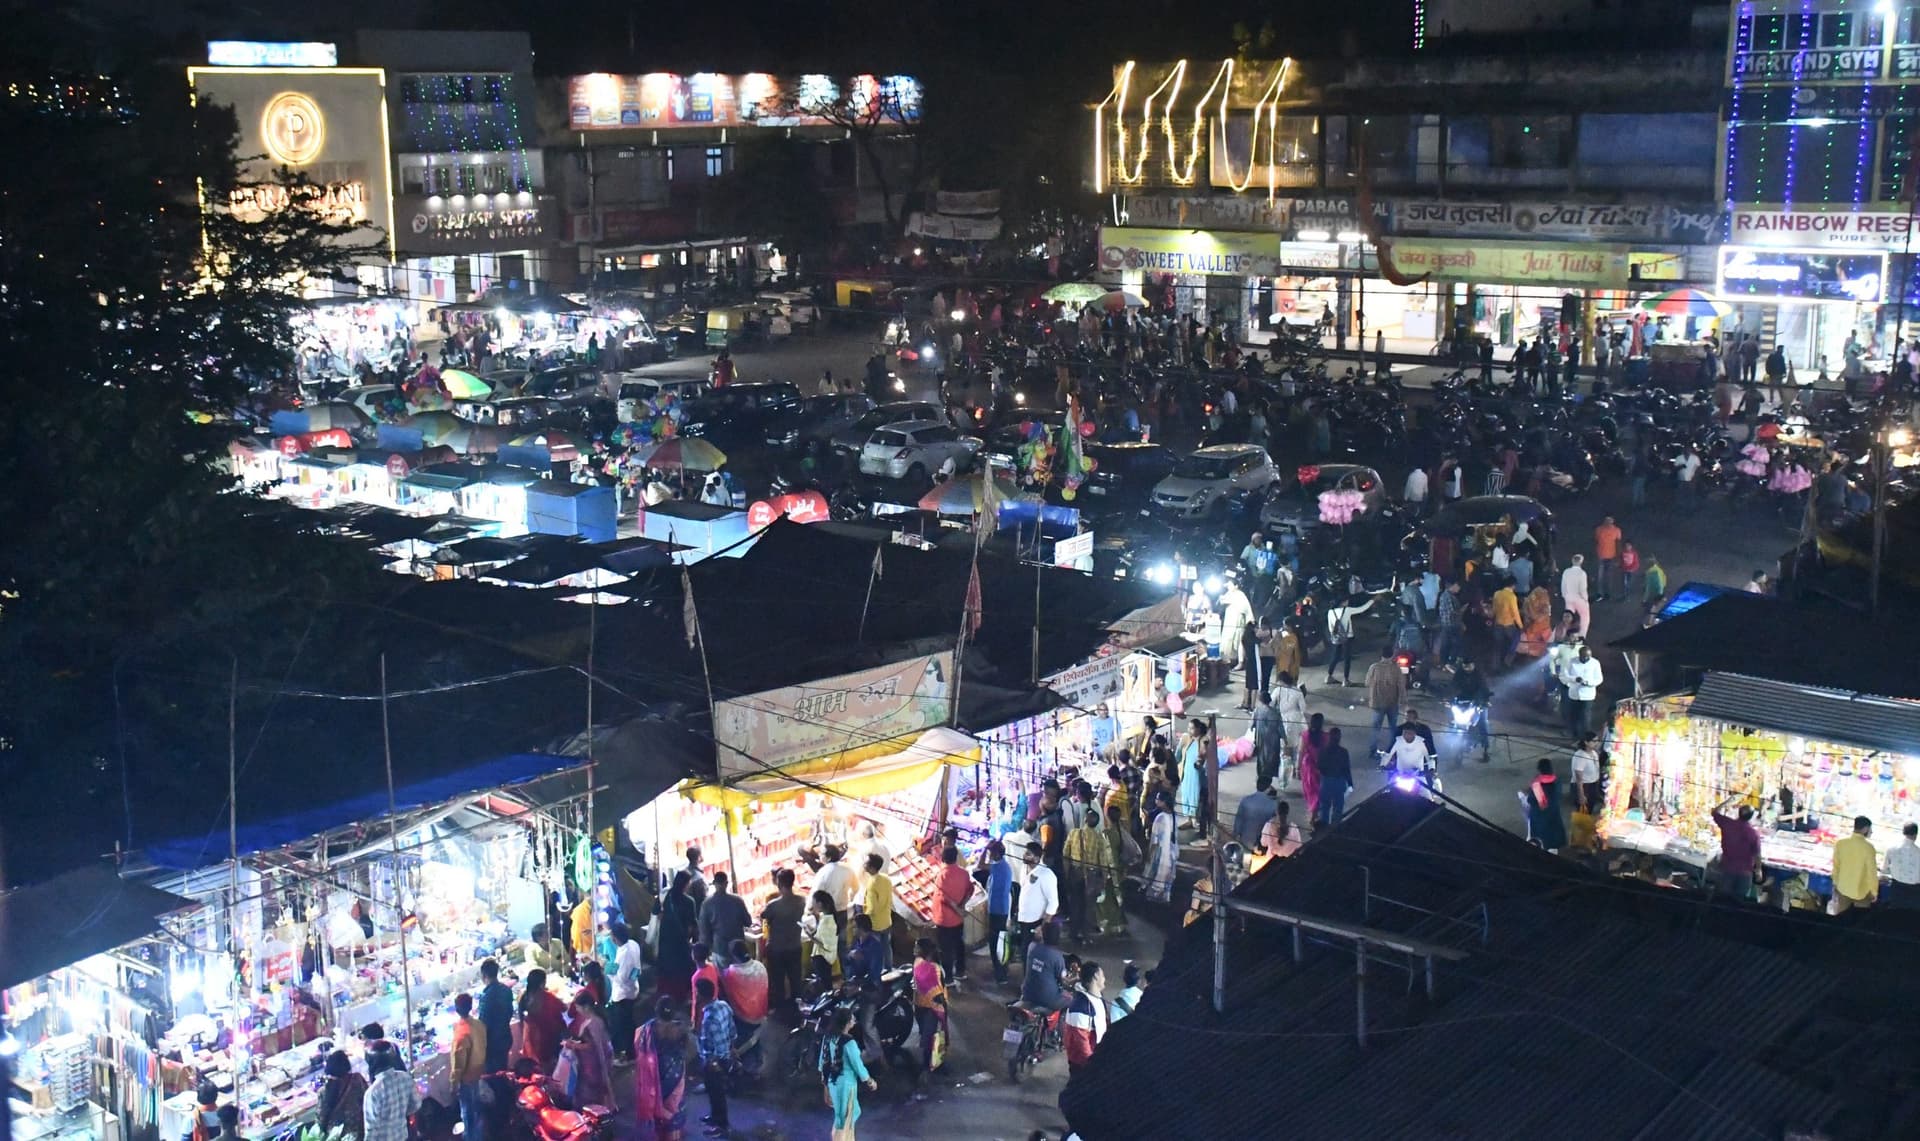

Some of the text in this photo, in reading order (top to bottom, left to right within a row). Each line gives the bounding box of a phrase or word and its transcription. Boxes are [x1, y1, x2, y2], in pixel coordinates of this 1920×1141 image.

[1739, 52, 1831, 71] MARTAND
[1839, 50, 1880, 70] GYM
[1295, 200, 1349, 215] PARAG
[1408, 203, 1447, 222] जय
[1538, 204, 1584, 225] Jai
[1736, 214, 1849, 232] RAINBOW
[1829, 234, 1866, 243] PURE
[1136, 251, 1242, 273] SWEET VALLEY
[1519, 250, 1605, 275] Jai Tulsi
